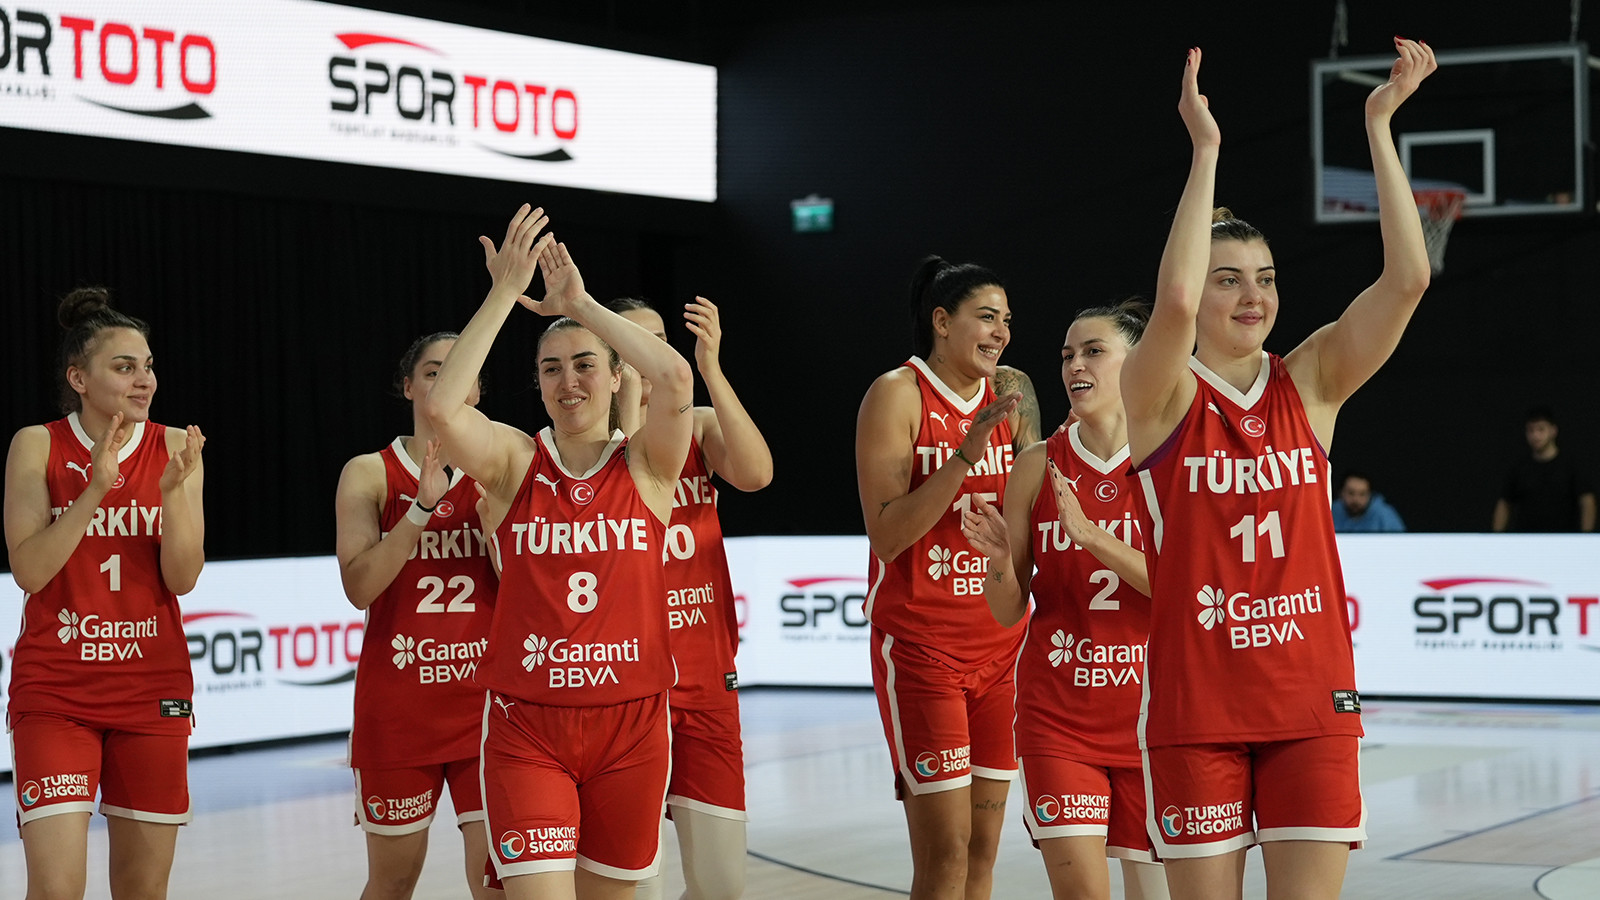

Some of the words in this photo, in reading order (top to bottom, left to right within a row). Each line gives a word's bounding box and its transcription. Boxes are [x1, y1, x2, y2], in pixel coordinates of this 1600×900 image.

[329, 57, 579, 140] SPORTOTO
[1183, 445, 1317, 495] TÜRKİYE
[512, 513, 648, 555] TÜRKİYE
[1230, 510, 1286, 562] 11
[100, 554, 121, 591] 1
[1088, 569, 1120, 610] 2
[416, 575, 476, 613] 22
[567, 571, 599, 613] 8
[1227, 586, 1322, 622] Garanti
[80, 614, 157, 639] Garanti
[1230, 618, 1304, 650] BBVA
[81, 641, 143, 661] BBVA
[548, 637, 640, 663] Garanti
[549, 665, 619, 688] BBVA
[1074, 667, 1140, 687] BBVA
